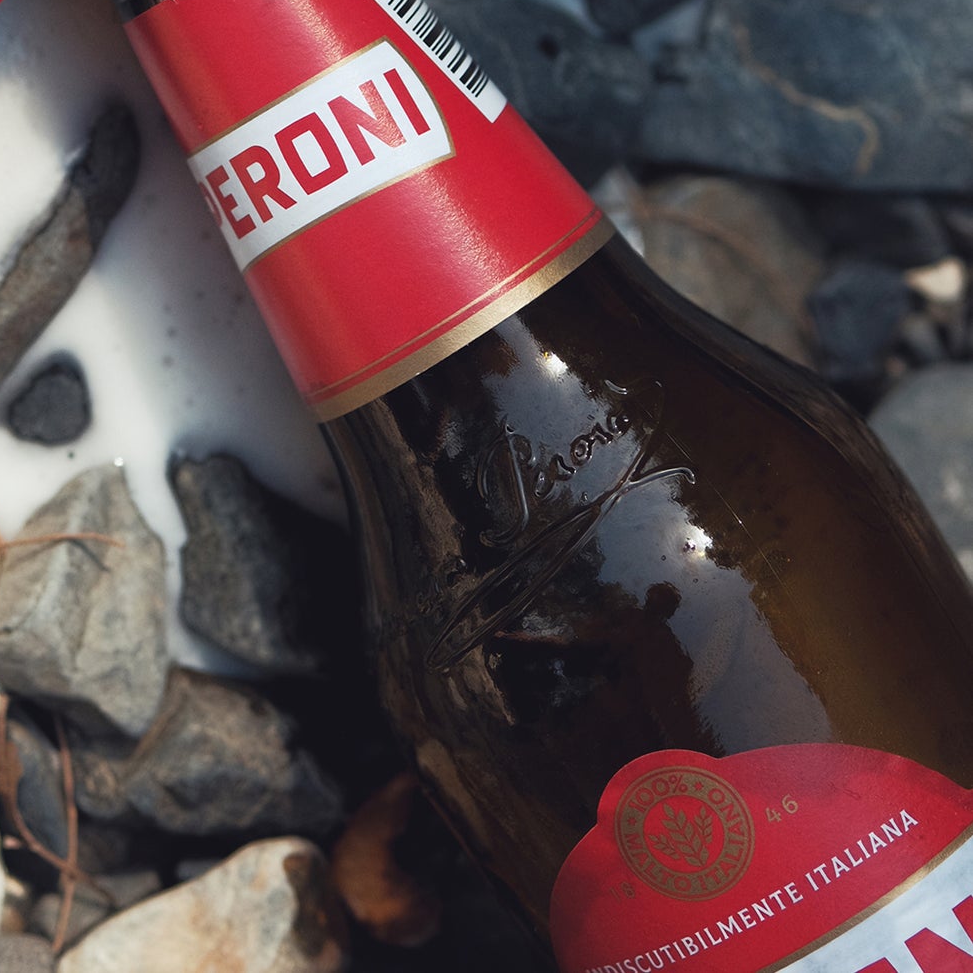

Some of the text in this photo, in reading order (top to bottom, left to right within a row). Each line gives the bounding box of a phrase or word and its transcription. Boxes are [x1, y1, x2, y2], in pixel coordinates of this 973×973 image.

[765, 793, 799, 823] 46
[586, 882, 804, 973] ISCUTIBILMENTE
[805, 809, 919, 892] ITALIANA
